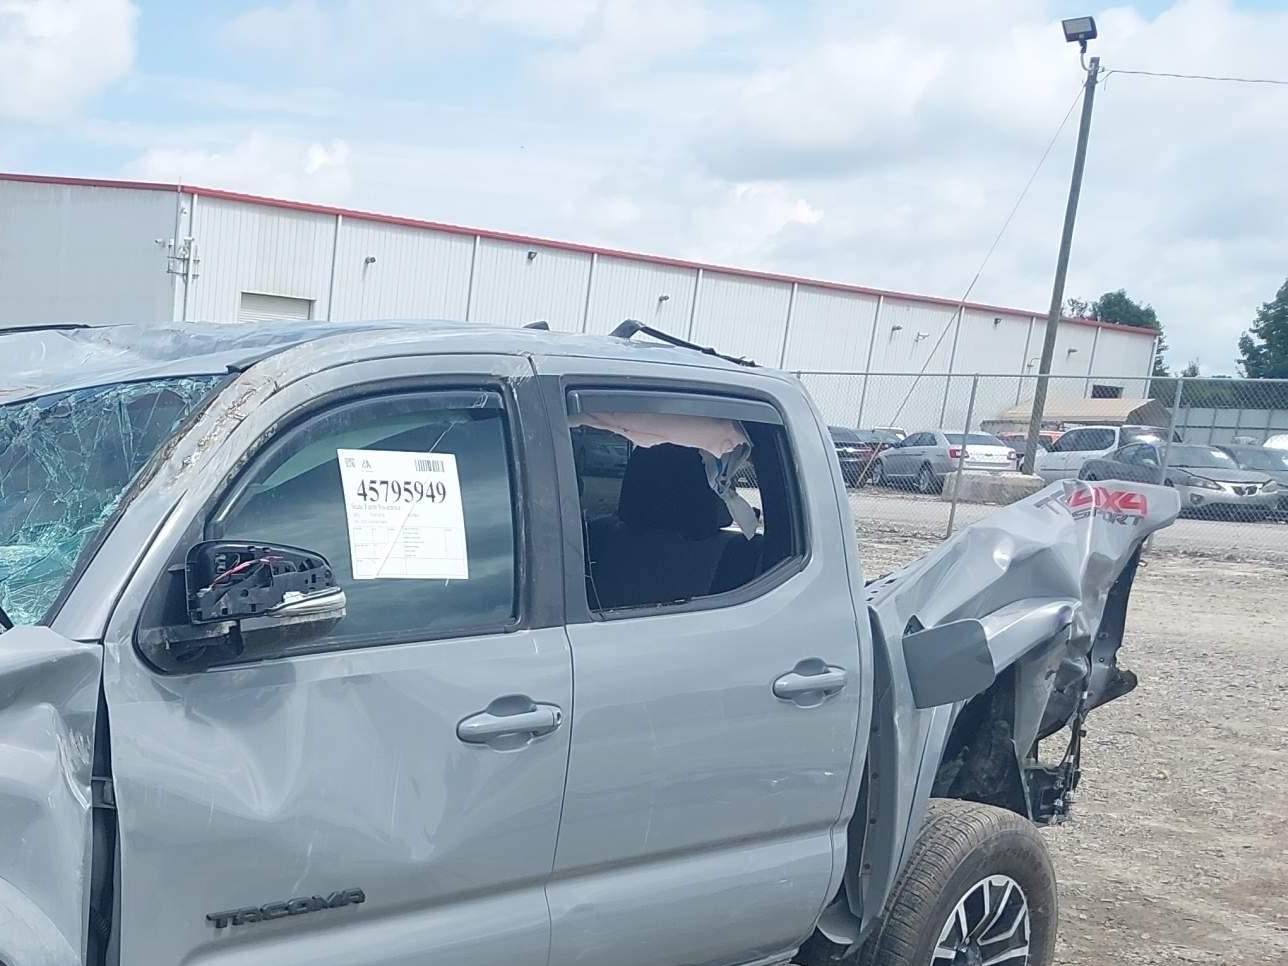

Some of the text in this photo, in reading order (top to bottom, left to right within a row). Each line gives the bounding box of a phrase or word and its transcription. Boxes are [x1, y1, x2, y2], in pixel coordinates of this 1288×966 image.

[357, 480, 447, 504] 45795949
[1071, 506, 1145, 527] SPORT
[206, 888, 365, 929] TACOMA
